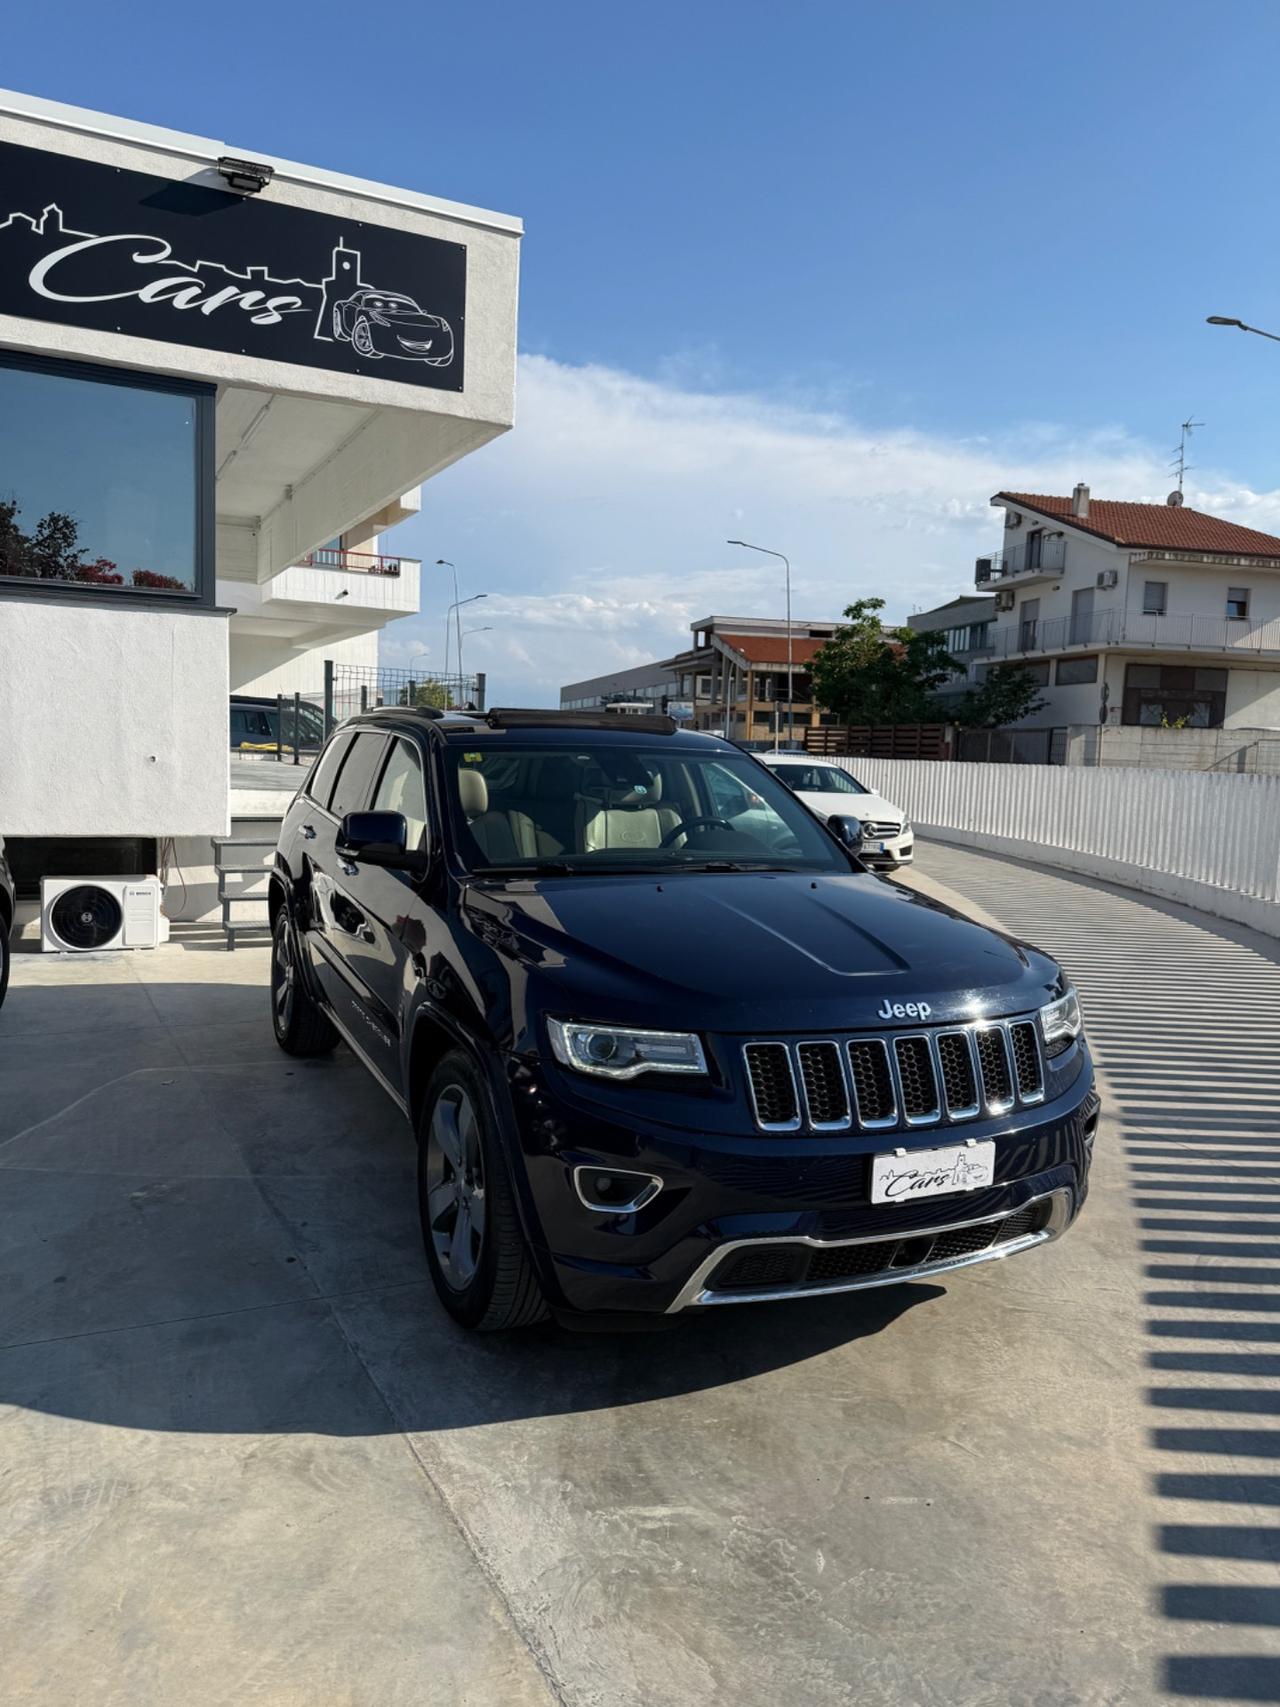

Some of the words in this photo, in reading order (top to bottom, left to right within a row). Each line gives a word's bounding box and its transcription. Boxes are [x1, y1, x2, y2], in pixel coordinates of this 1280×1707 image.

[29, 234, 312, 325] Cars
[878, 1000, 931, 1020] Jeep
[885, 1170, 949, 1197] Cars
